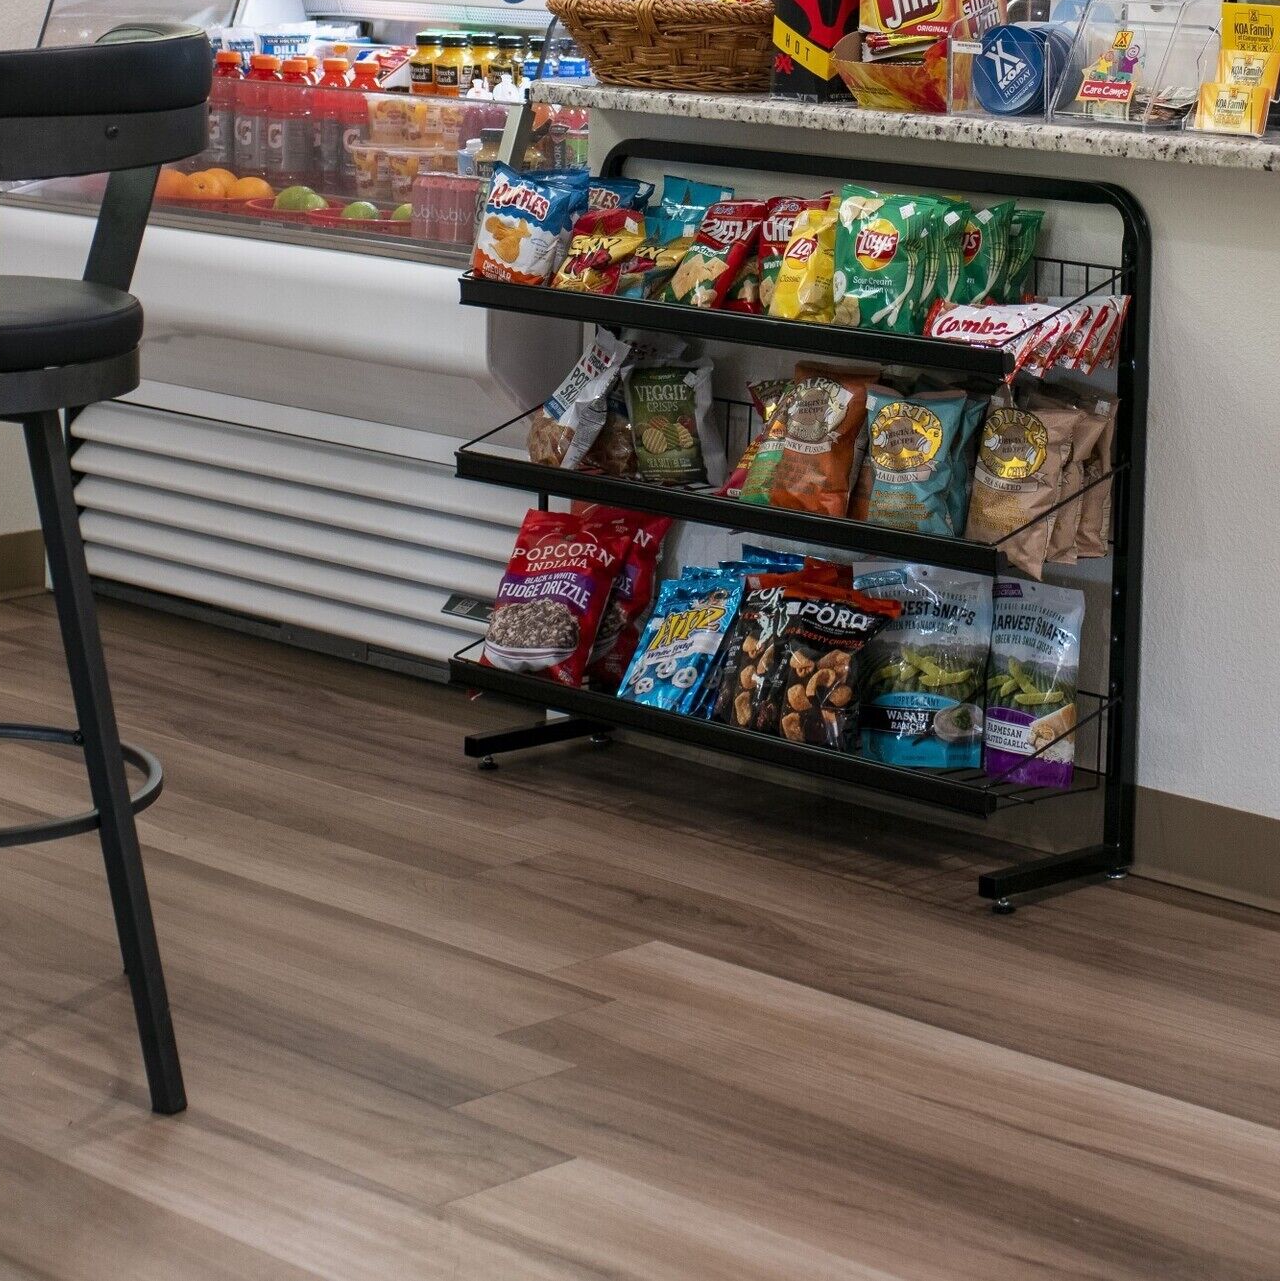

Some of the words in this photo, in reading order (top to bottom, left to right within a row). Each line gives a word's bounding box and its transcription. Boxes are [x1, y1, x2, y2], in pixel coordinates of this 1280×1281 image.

[916, 25, 949, 33] ORIGINAL
[1234, 22, 1249, 35] KOA
[1249, 24, 1274, 40] Family
[785, 33, 811, 62] HOT
[999, 60, 1027, 91] KOA
[1004, 69, 1032, 98] HOLIDAY
[1083, 84, 1101, 94] Care
[1102, 86, 1129, 97] Camps
[488, 182, 550, 221] RUFFLES
[852, 276, 870, 286] Sour
[870, 276, 893, 287] Cream
[634, 383, 688, 402] VEGGIE
[646, 401, 680, 413] CRISPS
[512, 542, 616, 568] POPCORN
[525, 556, 588, 572] INDIANA
[524, 573, 548, 585] BLACK
[553, 572, 578, 582] WHITE
[498, 582, 538, 598] FUDGE
[540, 580, 591, 610] DRIZZLE
[933, 600, 977, 626] SNAPS
[1036, 616, 1070, 646] SNAPS
[886, 709, 930, 723] WASABI
[891, 721, 926, 731] RANCH
[987, 722, 1023, 739] PARMESAN
[1003, 736, 1029, 751] GARLIC
